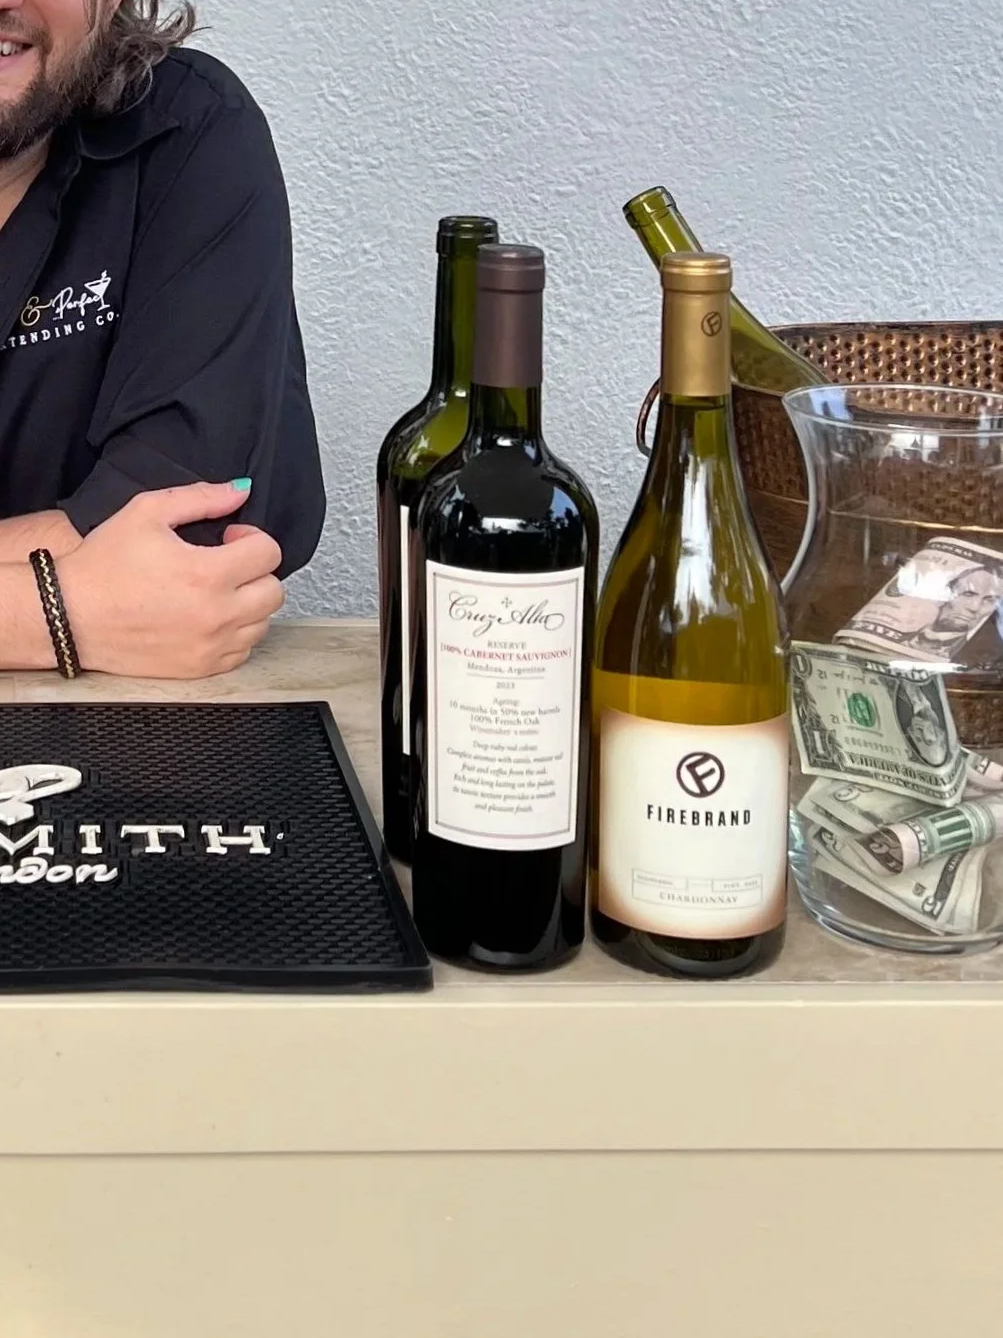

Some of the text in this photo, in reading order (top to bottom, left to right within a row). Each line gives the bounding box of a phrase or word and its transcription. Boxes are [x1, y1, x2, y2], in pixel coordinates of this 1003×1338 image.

[0, 311, 119, 350] TENDING CO.
[448, 590, 565, 638] Cruz Alta
[487, 640, 527, 650] RESERVE
[463, 648, 514, 661] CABERNET
[470, 712, 540, 726] 100% French Oak
[647, 804, 751, 827] FIREBRAND
[659, 891, 739, 904] CHARDONNAY
